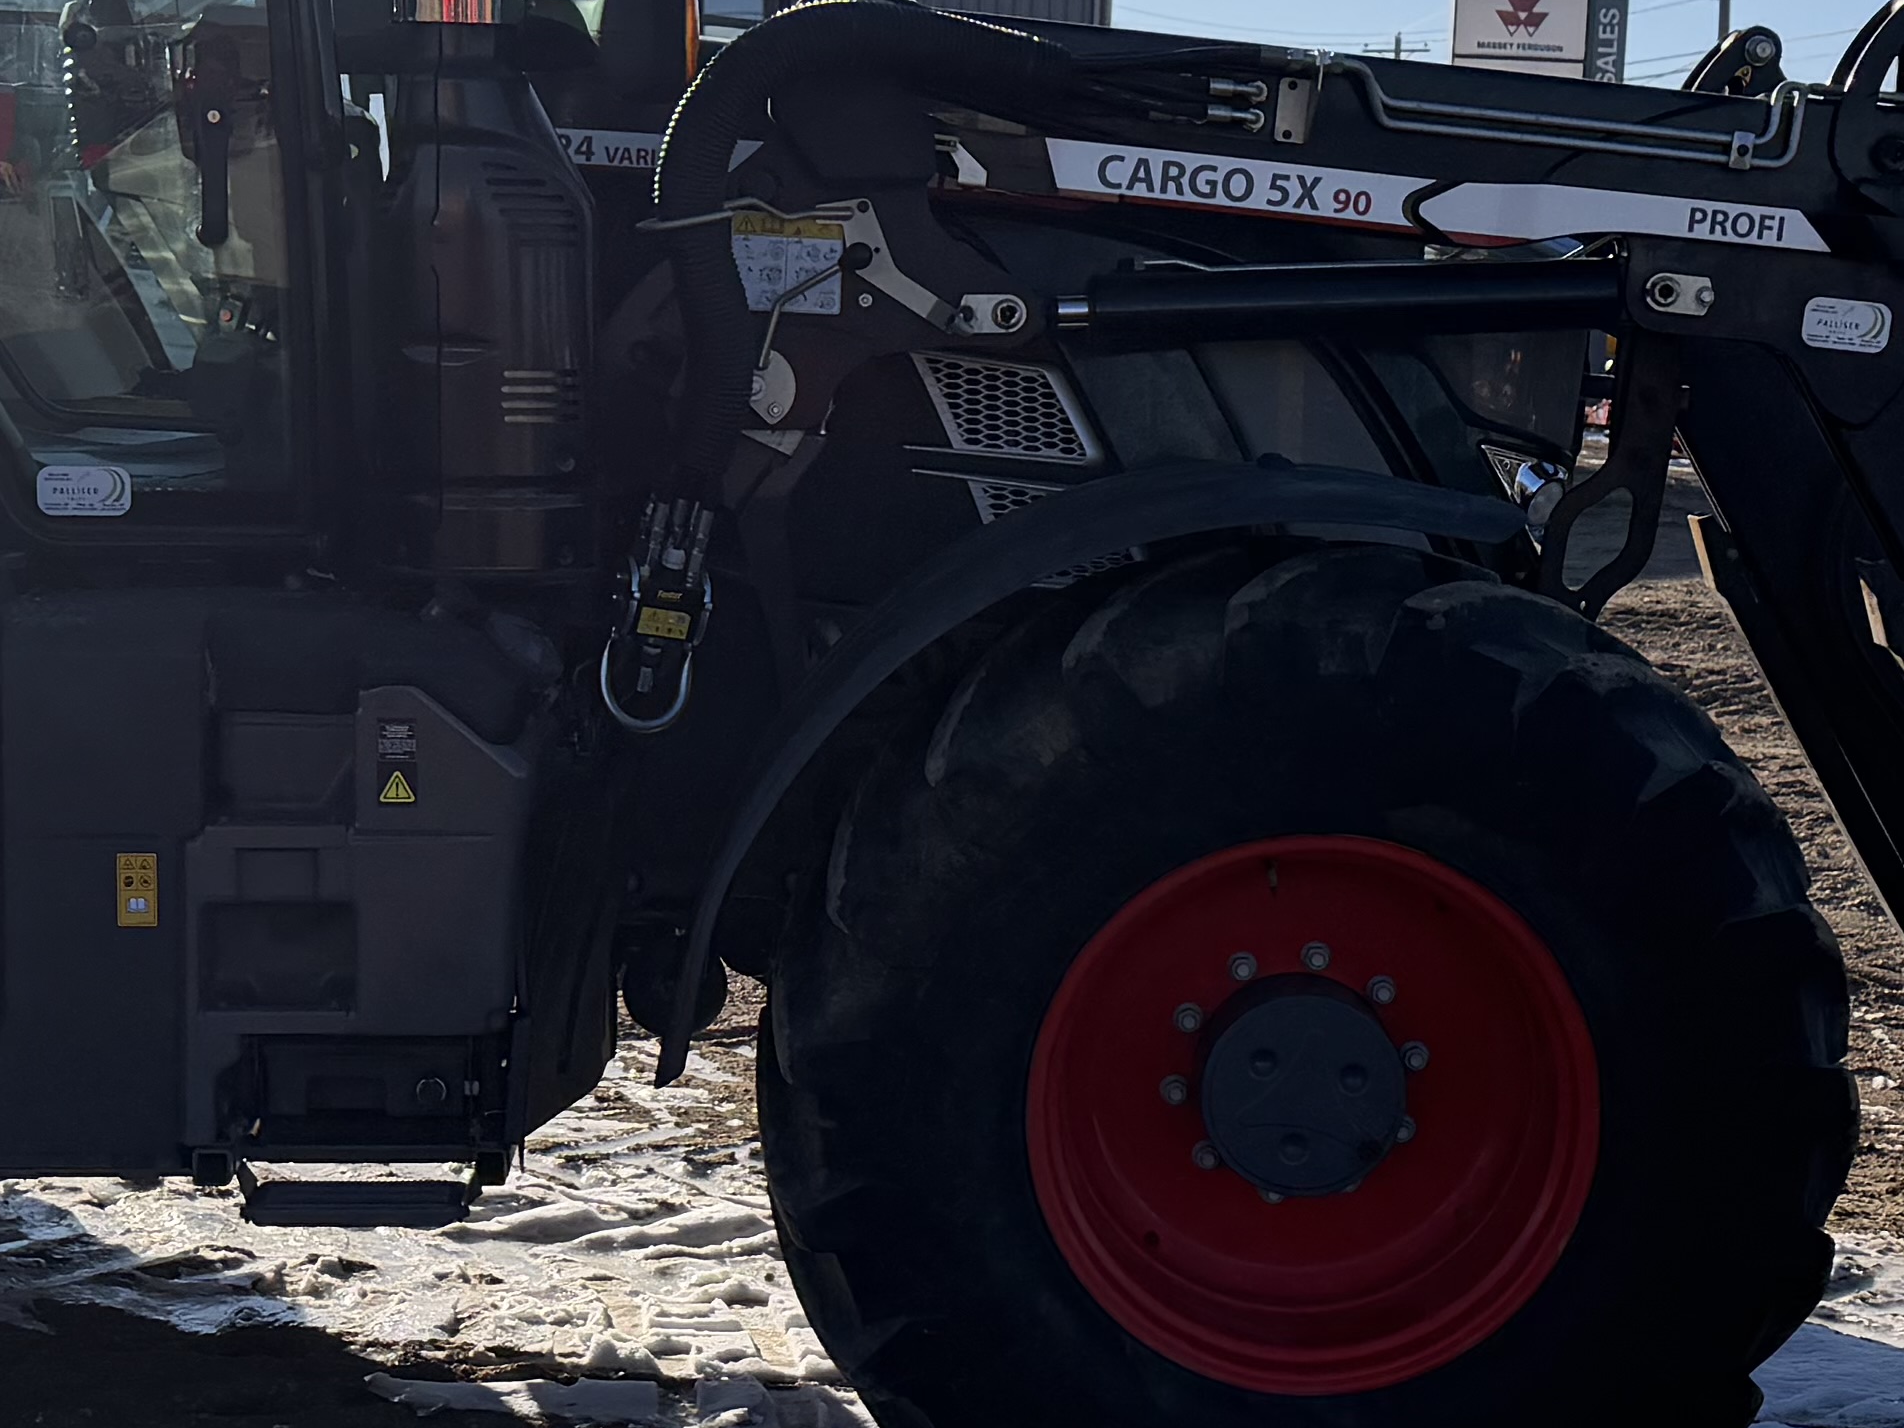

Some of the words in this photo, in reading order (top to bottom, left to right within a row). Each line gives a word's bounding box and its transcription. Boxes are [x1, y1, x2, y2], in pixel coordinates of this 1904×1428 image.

[1477, 40, 1515, 52] MASSEY
[1594, 7, 1621, 83] SALES
[1097, 154, 1255, 203] CARGO
[1266, 172, 1324, 211] 5X
[1332, 188, 1372, 216] 90
[1687, 206, 1786, 242] PROFI
